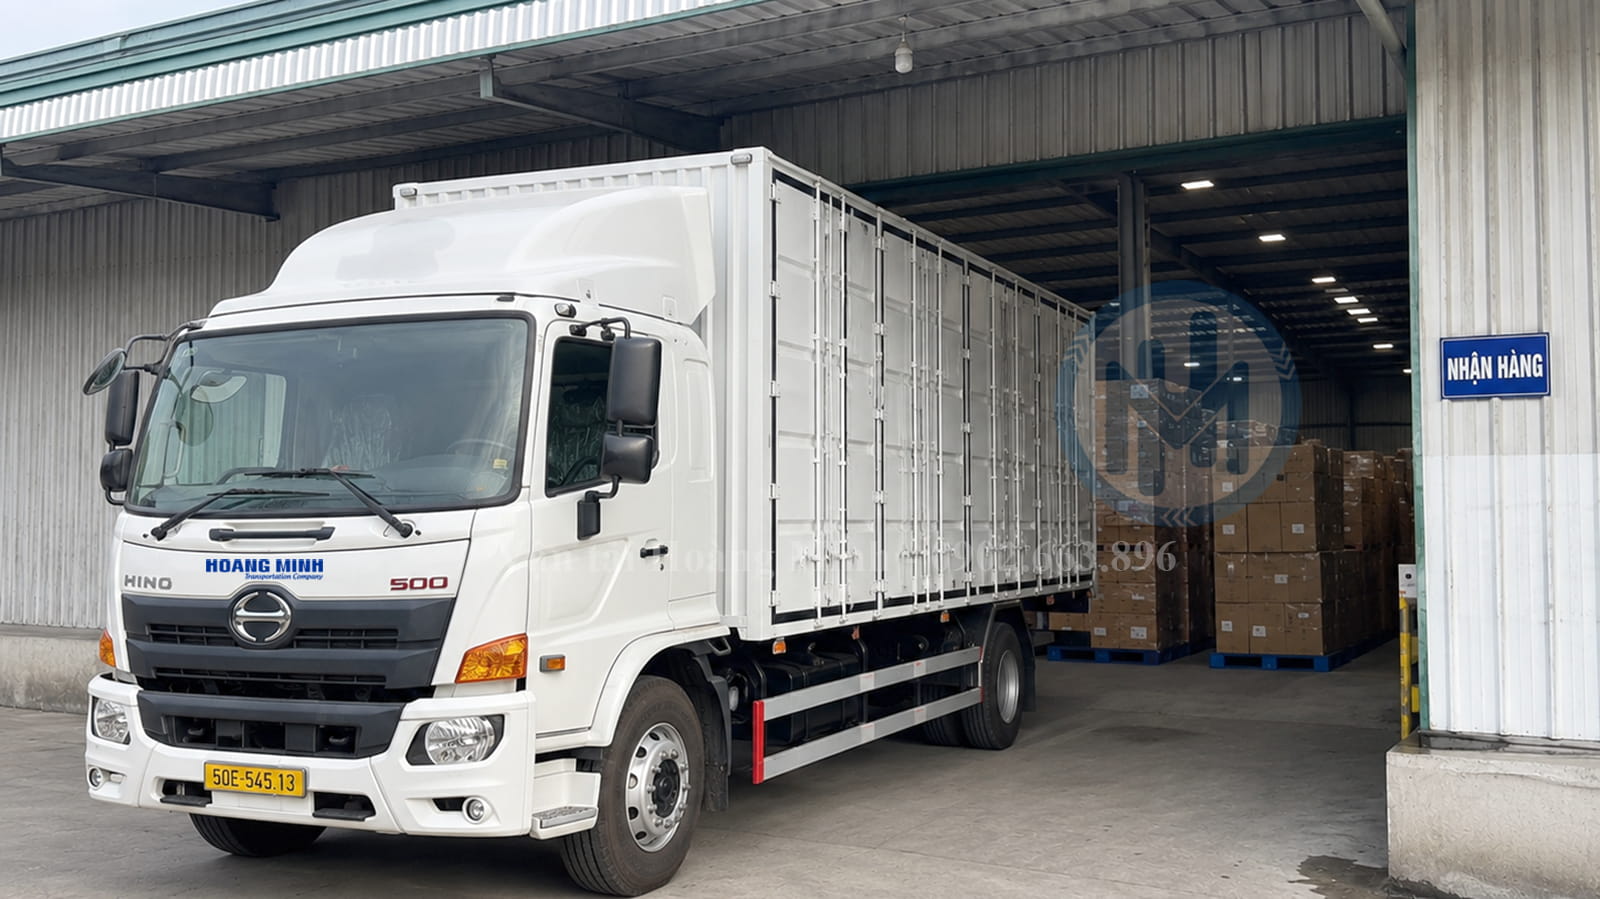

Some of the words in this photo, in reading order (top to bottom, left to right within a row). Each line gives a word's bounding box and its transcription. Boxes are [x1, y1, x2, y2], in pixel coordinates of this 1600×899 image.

[1447, 351, 1492, 385] NHẬN
[1497, 348, 1543, 379] HÀNG
[205, 558, 271, 573] HOANG
[275, 558, 324, 573] MINH
[124, 574, 172, 590] HINO
[245, 573, 291, 581] Transportation
[292, 573, 324, 581] Company
[390, 576, 448, 591] 500
[213, 768, 295, 792] 50E-545.13
